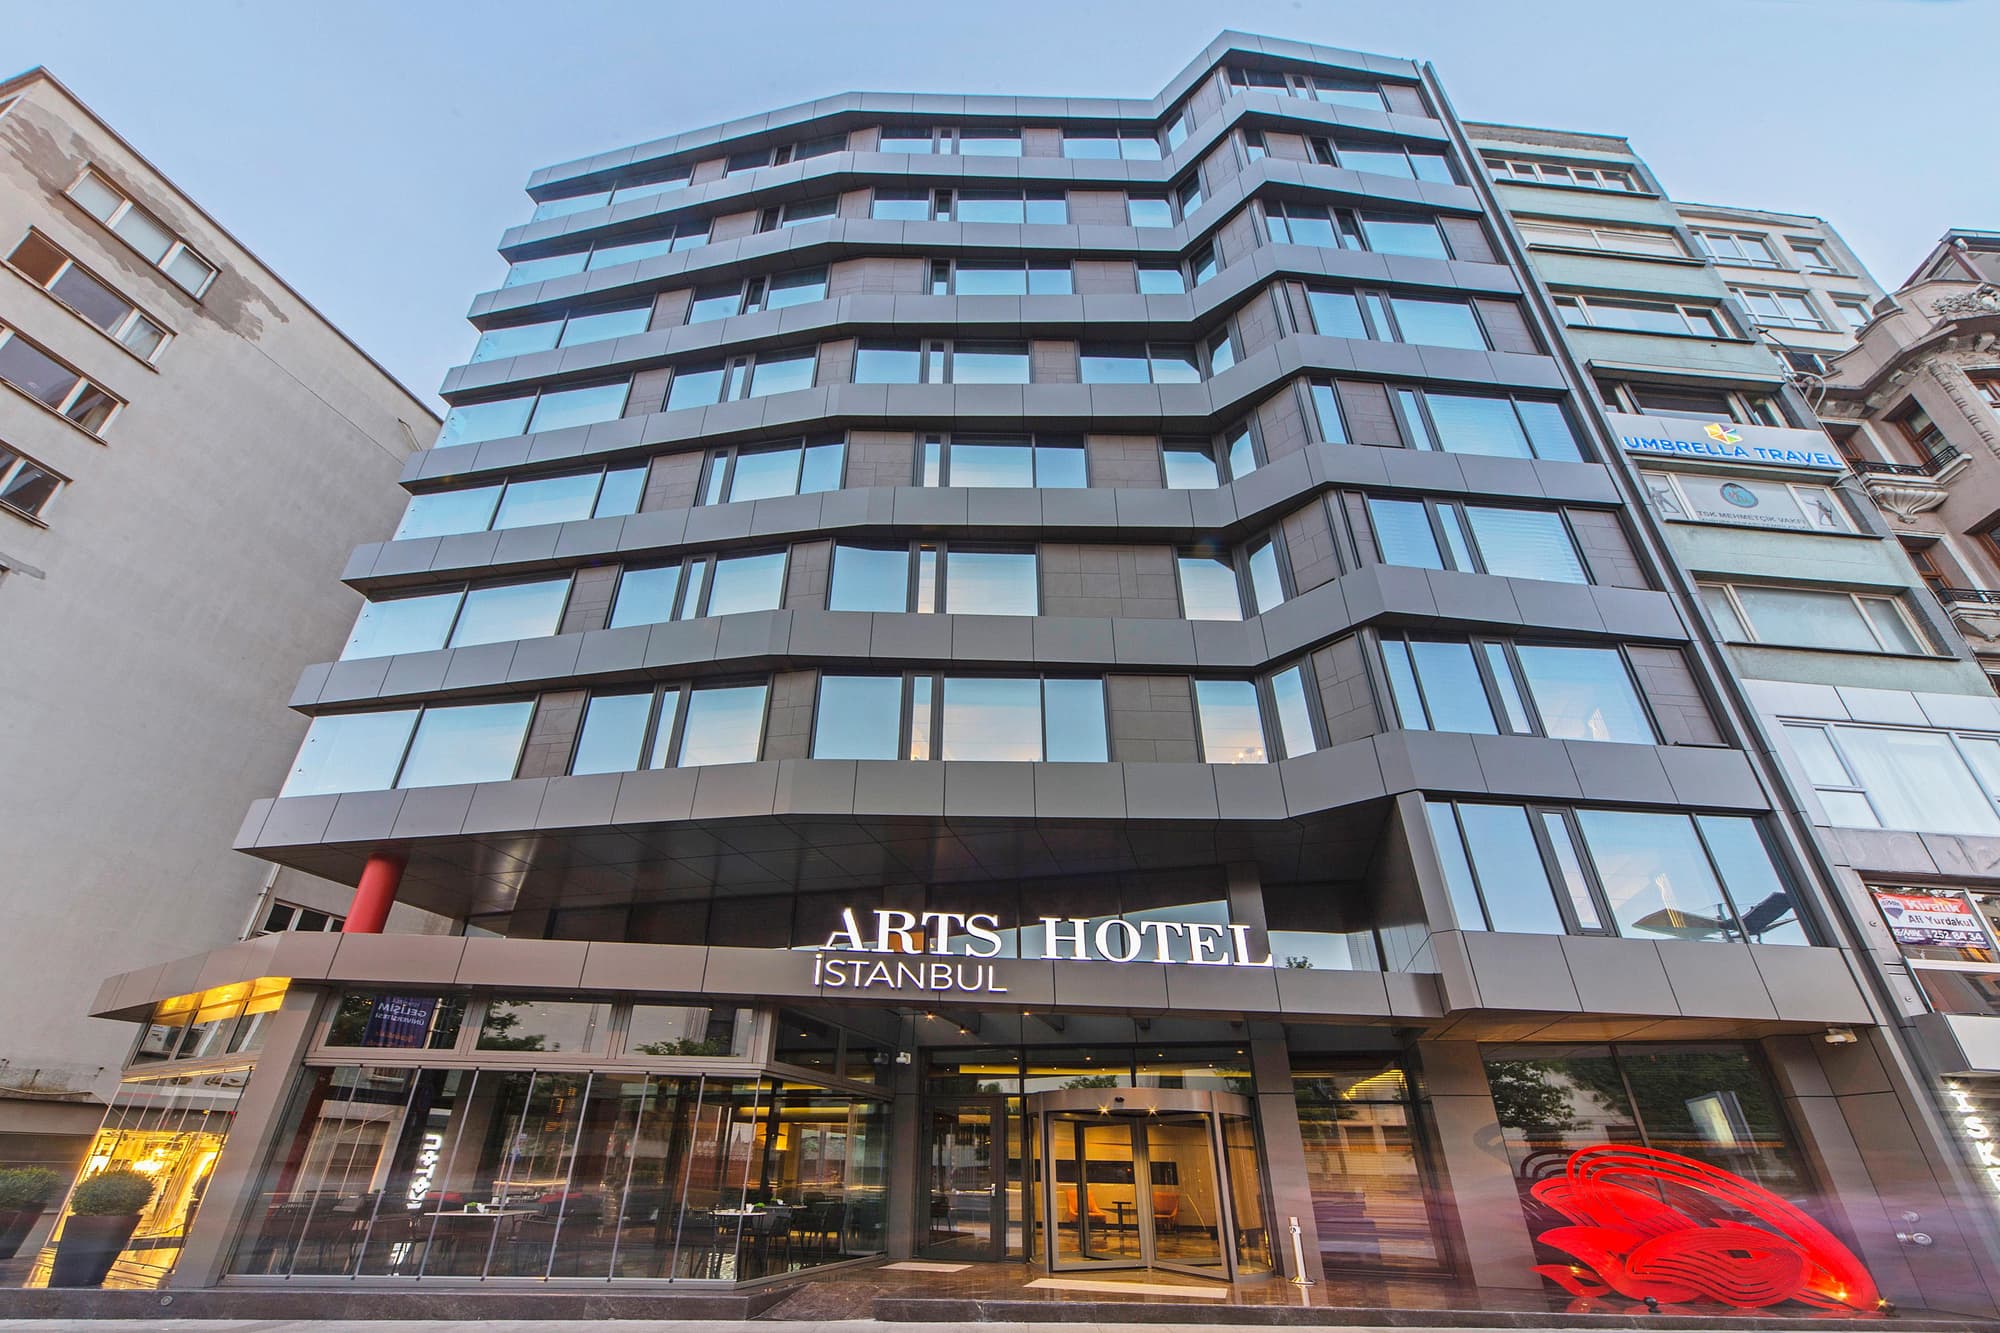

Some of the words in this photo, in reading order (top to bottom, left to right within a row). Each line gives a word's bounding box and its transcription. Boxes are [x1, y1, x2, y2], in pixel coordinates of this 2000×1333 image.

[1623, 436, 1749, 458] UMBRELLA
[1753, 447, 1843, 467] TRAVEL
[1908, 914, 1924, 924] Ali
[1924, 915, 1975, 927] Yurdakul
[1931, 930, 1952, 939] 252
[1967, 932, 1984, 941] 34
[820, 907, 1002, 959] ARTS
[1039, 917, 1273, 968] HOTEL
[813, 953, 1007, 993] İSTANBUL
